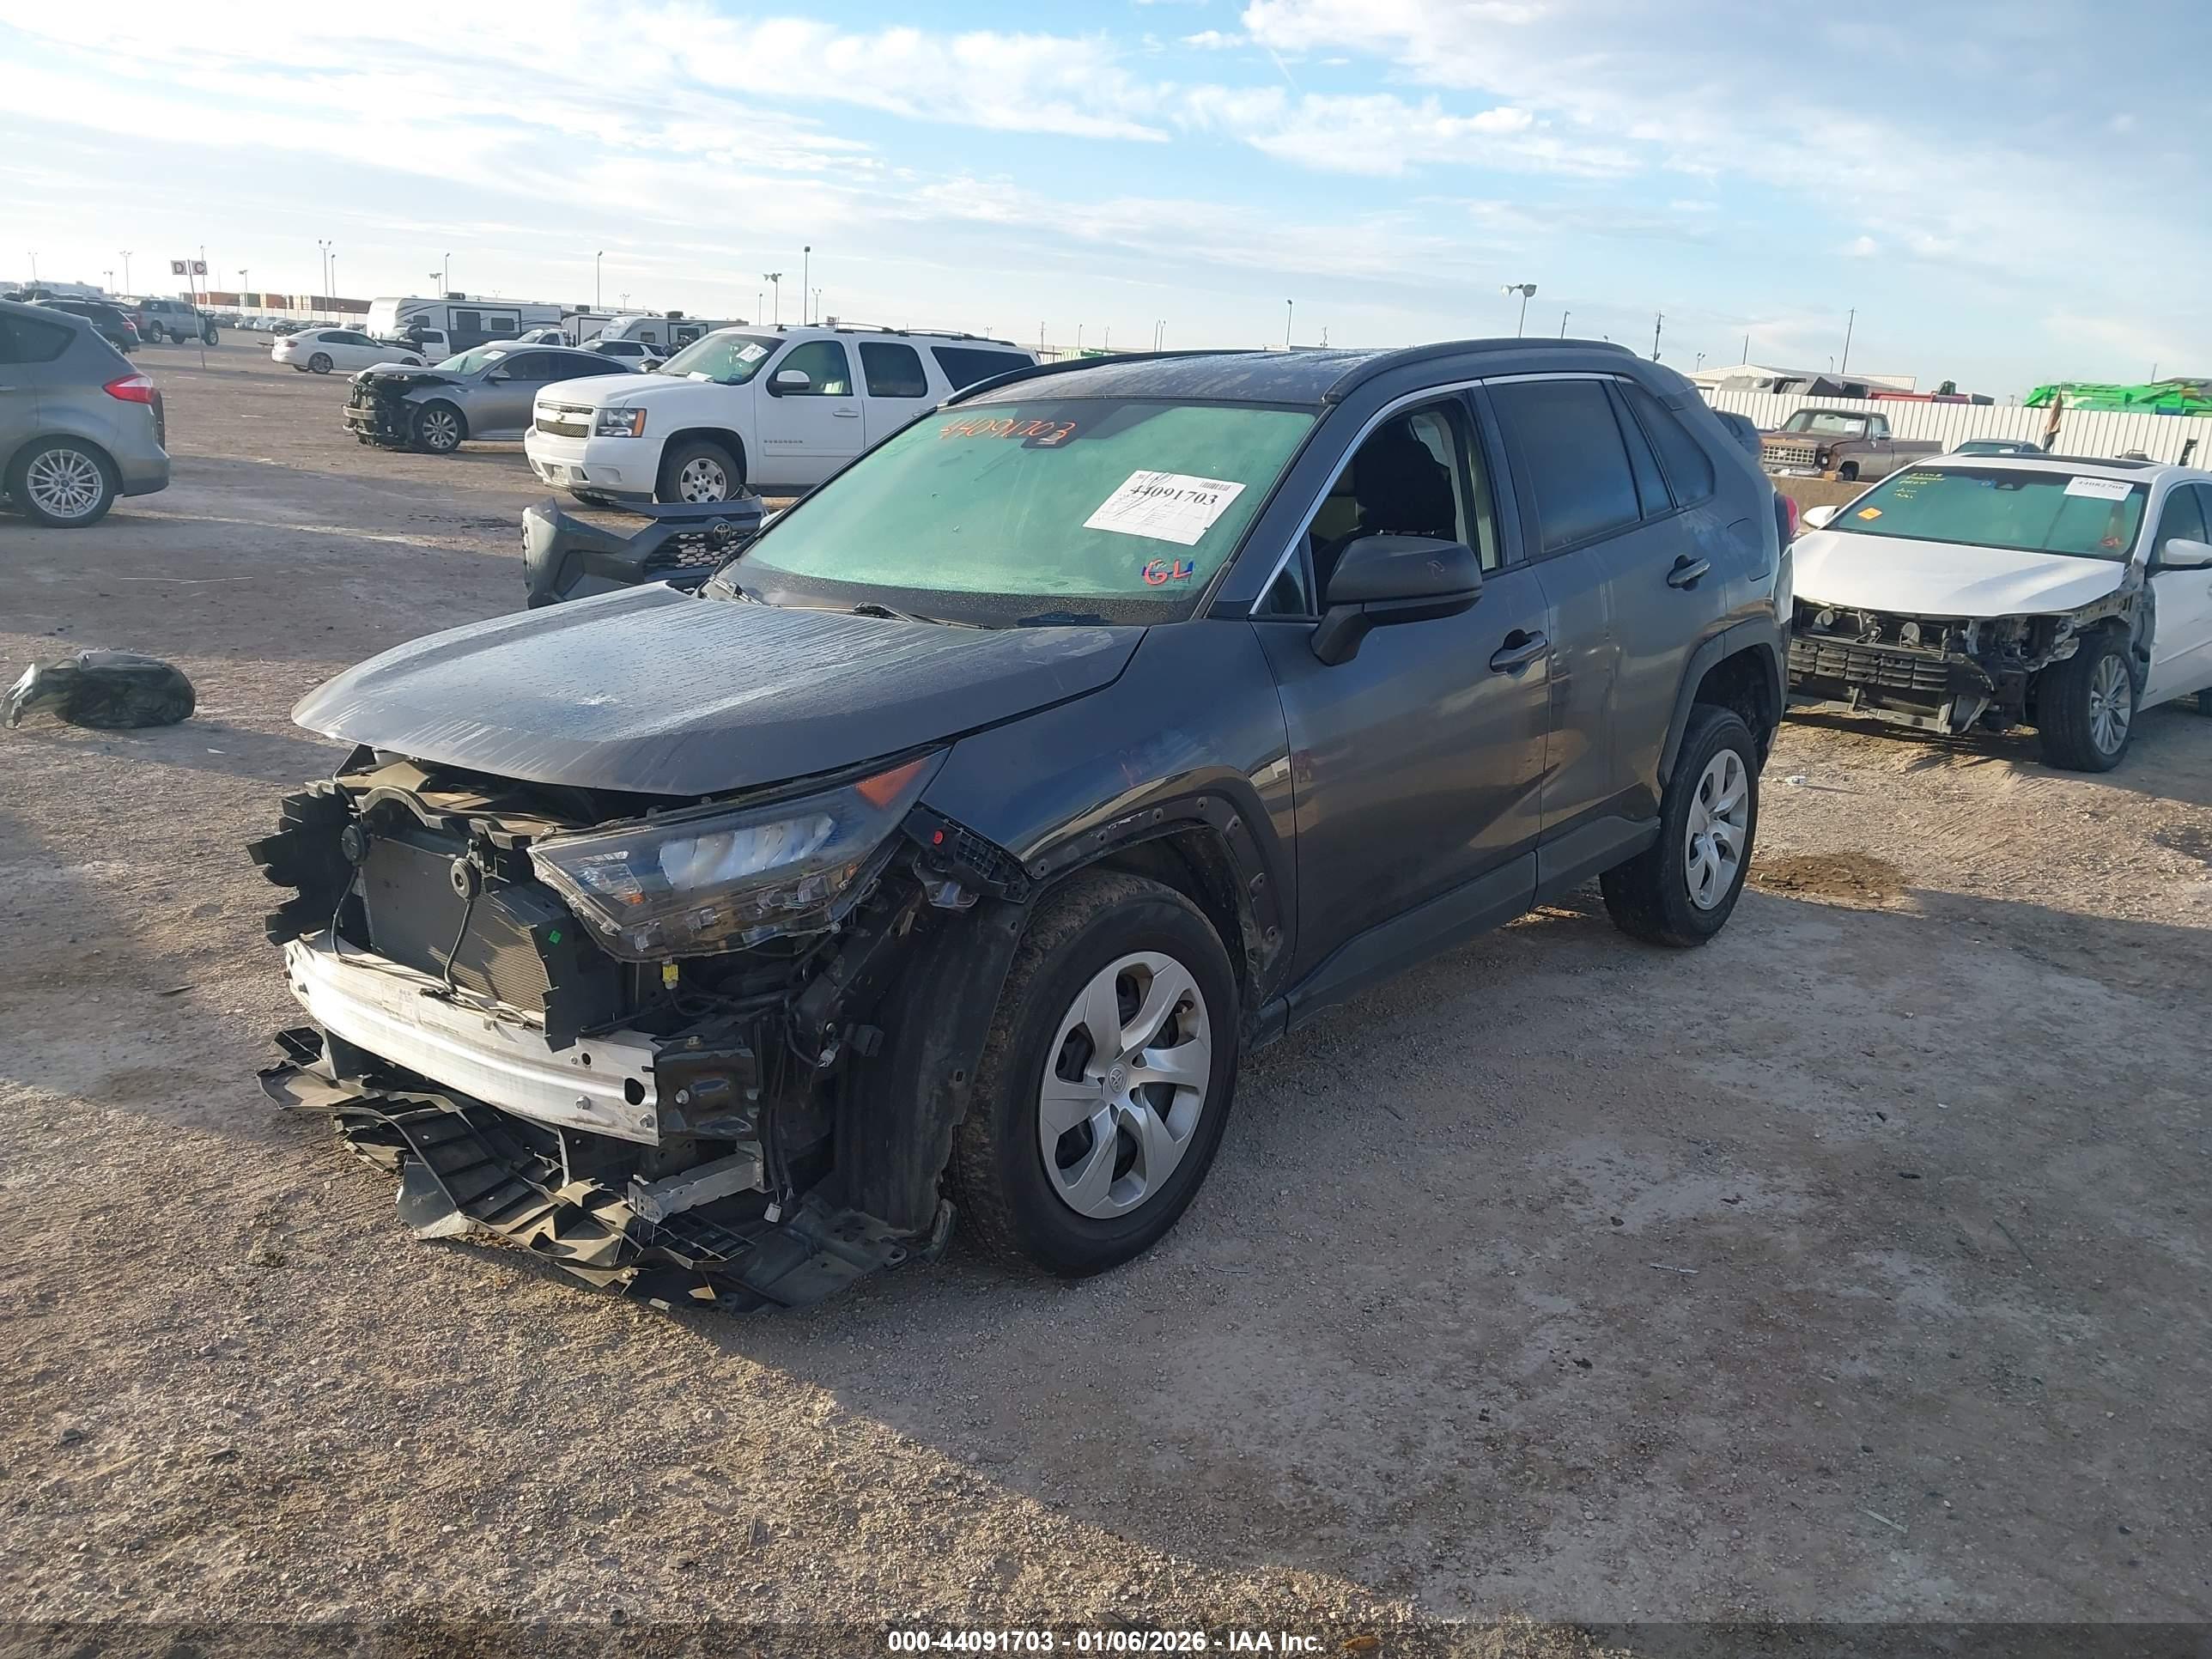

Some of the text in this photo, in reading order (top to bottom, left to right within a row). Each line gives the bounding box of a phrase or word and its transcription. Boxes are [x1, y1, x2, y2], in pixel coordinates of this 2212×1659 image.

[173, 262, 185, 274] D
[194, 262, 205, 274] C
[939, 417, 1075, 441] 44091703
[1130, 484, 1218, 506] 44091703
